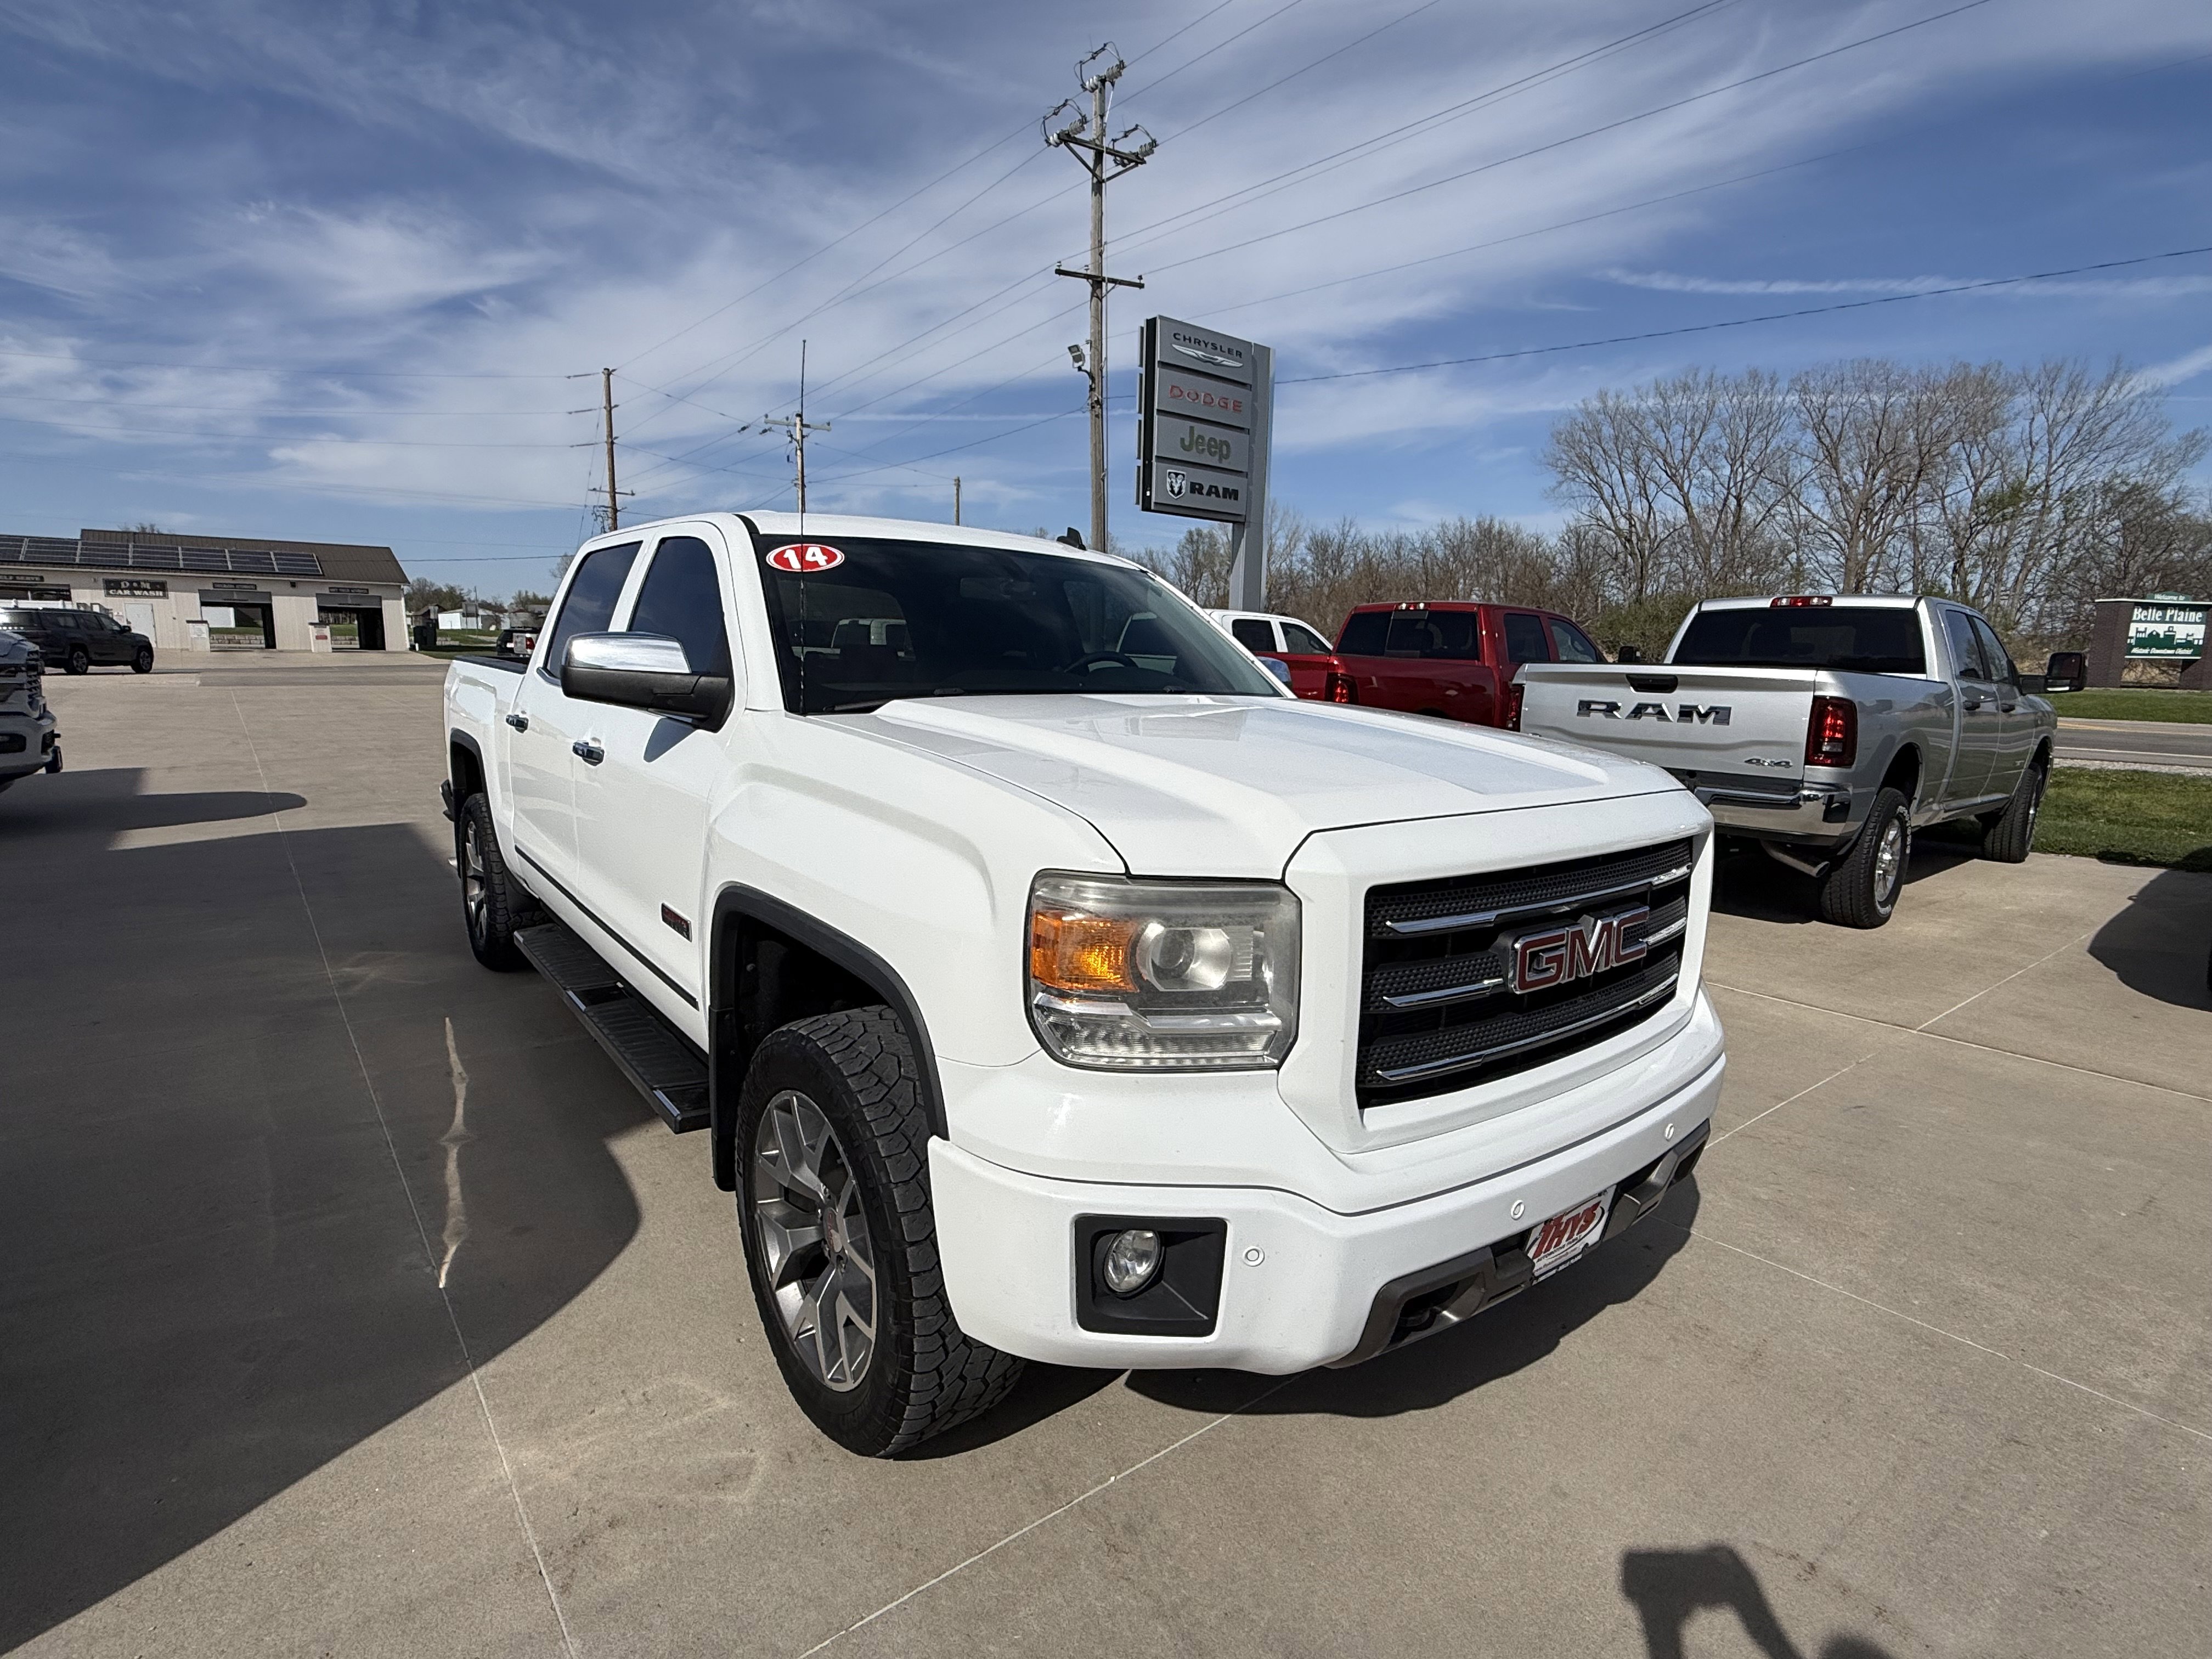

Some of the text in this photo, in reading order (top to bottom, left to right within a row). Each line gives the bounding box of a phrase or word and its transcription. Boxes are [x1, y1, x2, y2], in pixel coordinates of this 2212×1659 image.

[1173, 332, 1243, 358] CHRYSLER
[1169, 385, 1243, 413] DODGE
[1180, 426, 1231, 463] Jeep
[1189, 481, 1239, 501] RAM
[783, 546, 828, 569] 14
[2132, 606, 2203, 622] Belle Plaine
[1577, 699, 1732, 726] RAM
[1511, 904, 1650, 994] GMC
